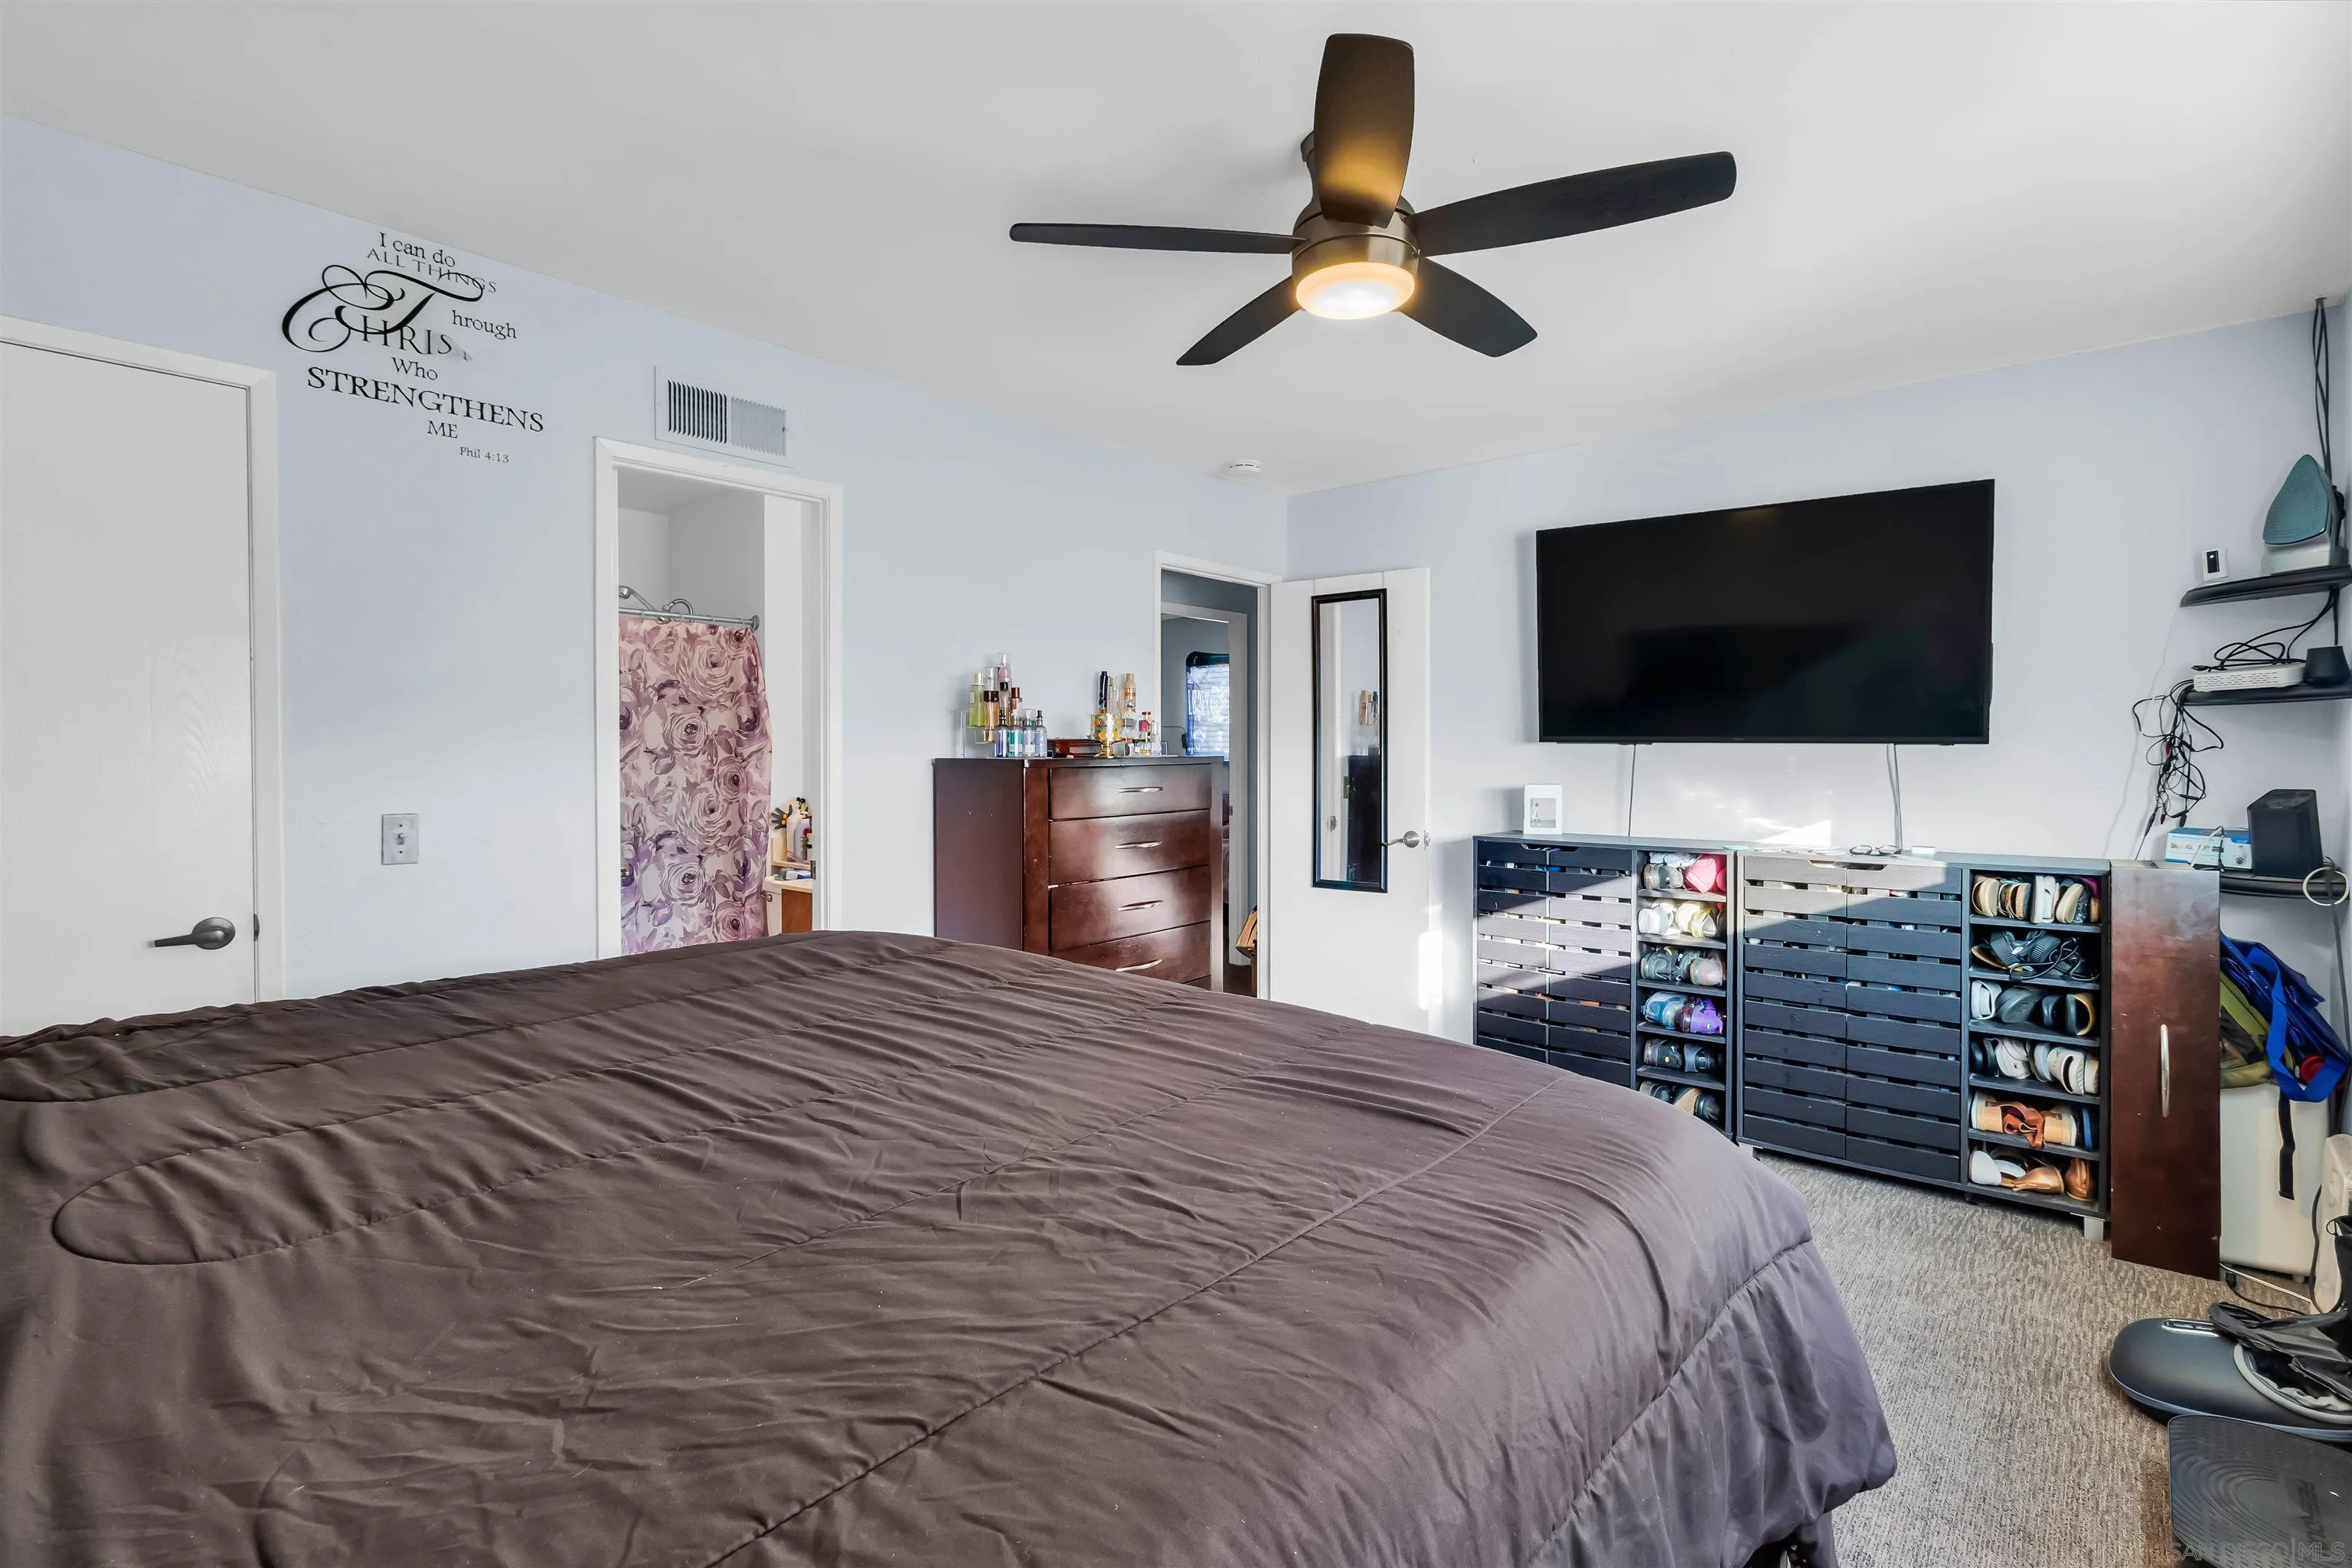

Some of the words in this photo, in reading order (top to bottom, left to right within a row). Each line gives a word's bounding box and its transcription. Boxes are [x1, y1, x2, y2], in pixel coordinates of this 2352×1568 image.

[379, 232, 387, 248] I
[392, 239, 426, 260] can
[433, 250, 456, 268] do
[367, 248, 406, 269] ALL
[413, 259, 498, 294] THINGS
[390, 356, 439, 381] Who
[307, 366, 544, 433] STRENGTHENS
[426, 420, 459, 439] ME
[459, 446, 482, 459] Phil
[484, 449, 510, 464] 4:13
